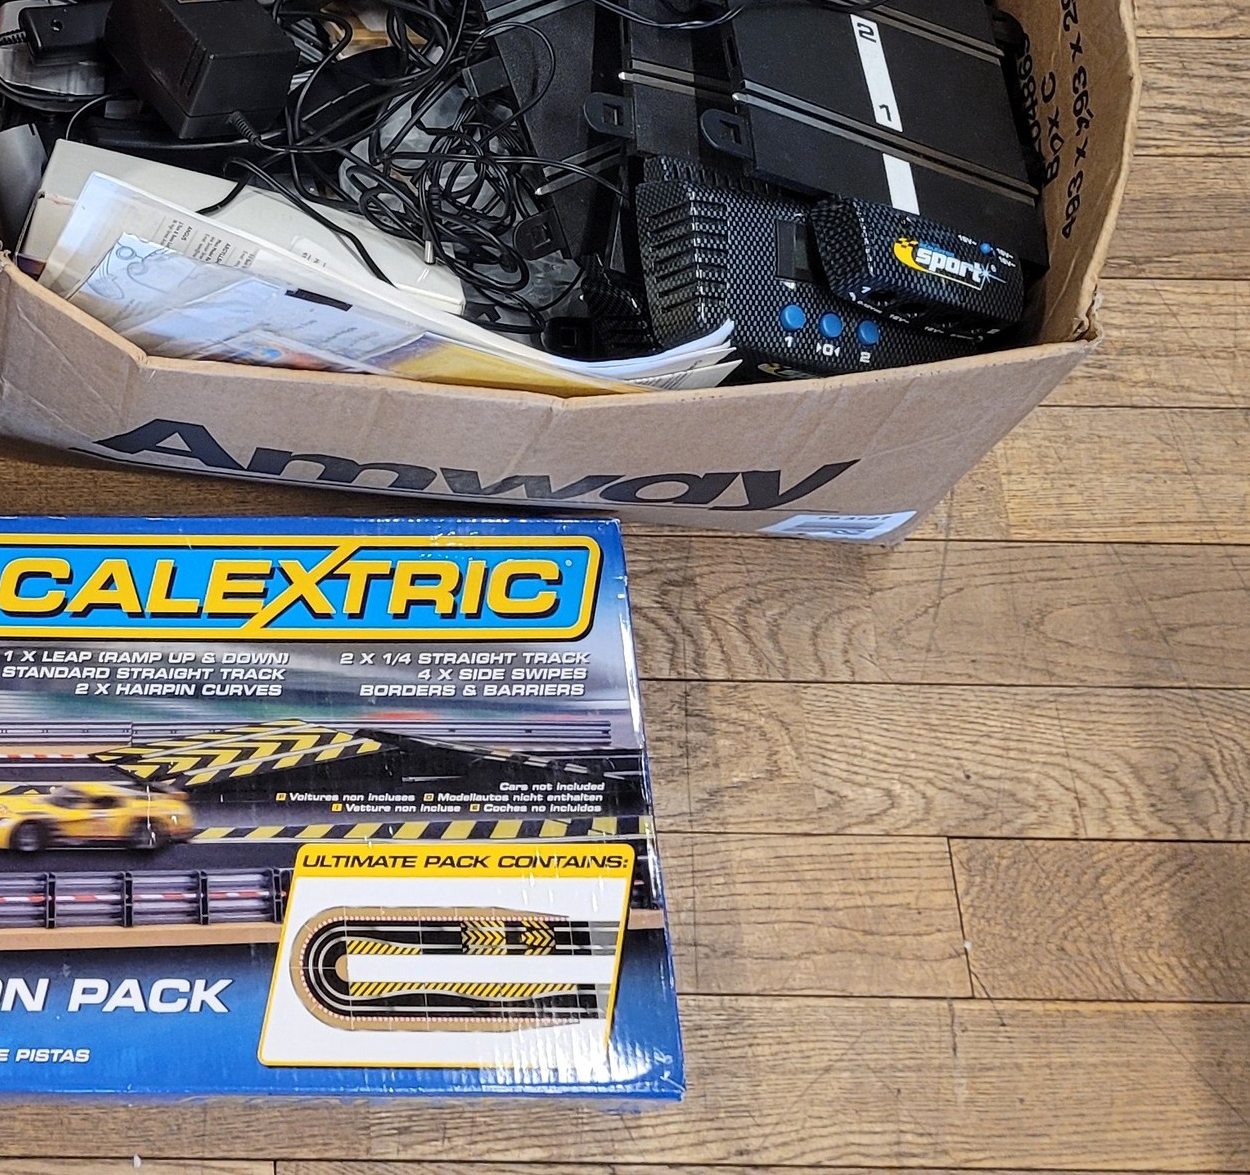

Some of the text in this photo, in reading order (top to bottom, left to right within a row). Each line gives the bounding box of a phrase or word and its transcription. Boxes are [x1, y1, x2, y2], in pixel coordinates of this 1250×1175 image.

[857, 22, 877, 44] 2
[1040, 71, 1056, 103] C
[879, 104, 892, 122] 1
[915, 247, 983, 283] sport
[859, 351, 871, 364] 2
[92, 418, 861, 511] Amway
[3, 650, 290, 665] 1 X LEAP (RAMP UP & DOWN)
[339, 652, 590, 666] 2 X 1/4 STRAIGHT TRACK
[1, 666, 110, 679] STANDARD
[116, 667, 213, 680] STRAIGHT
[219, 668, 286, 681] TRACK
[417, 668, 588, 681] 4 X SIDE SWIPES
[74, 683, 283, 697] 2 X HAIRPIN CURVES
[359, 684, 585, 697] BORDERS & BARRIERS
[499, 782, 605, 791] Cars not included
[289, 793, 339, 802] Voitures
[342, 794, 364, 802] non
[368, 793, 415, 802] incluses
[437, 793, 510, 802] Modellautos
[513, 793, 544, 801] nicht
[547, 793, 603, 802] enthalten
[346, 803, 391, 812] Vetture
[420, 804, 461, 812] incluse
[483, 803, 528, 812] Coches
[550, 804, 601, 812] incluidos
[302, 854, 629, 869] ULTIMATE PACK CONTAINS:
[67, 978, 234, 1014] PACK
[15, 1048, 91, 1063] PISTAS
